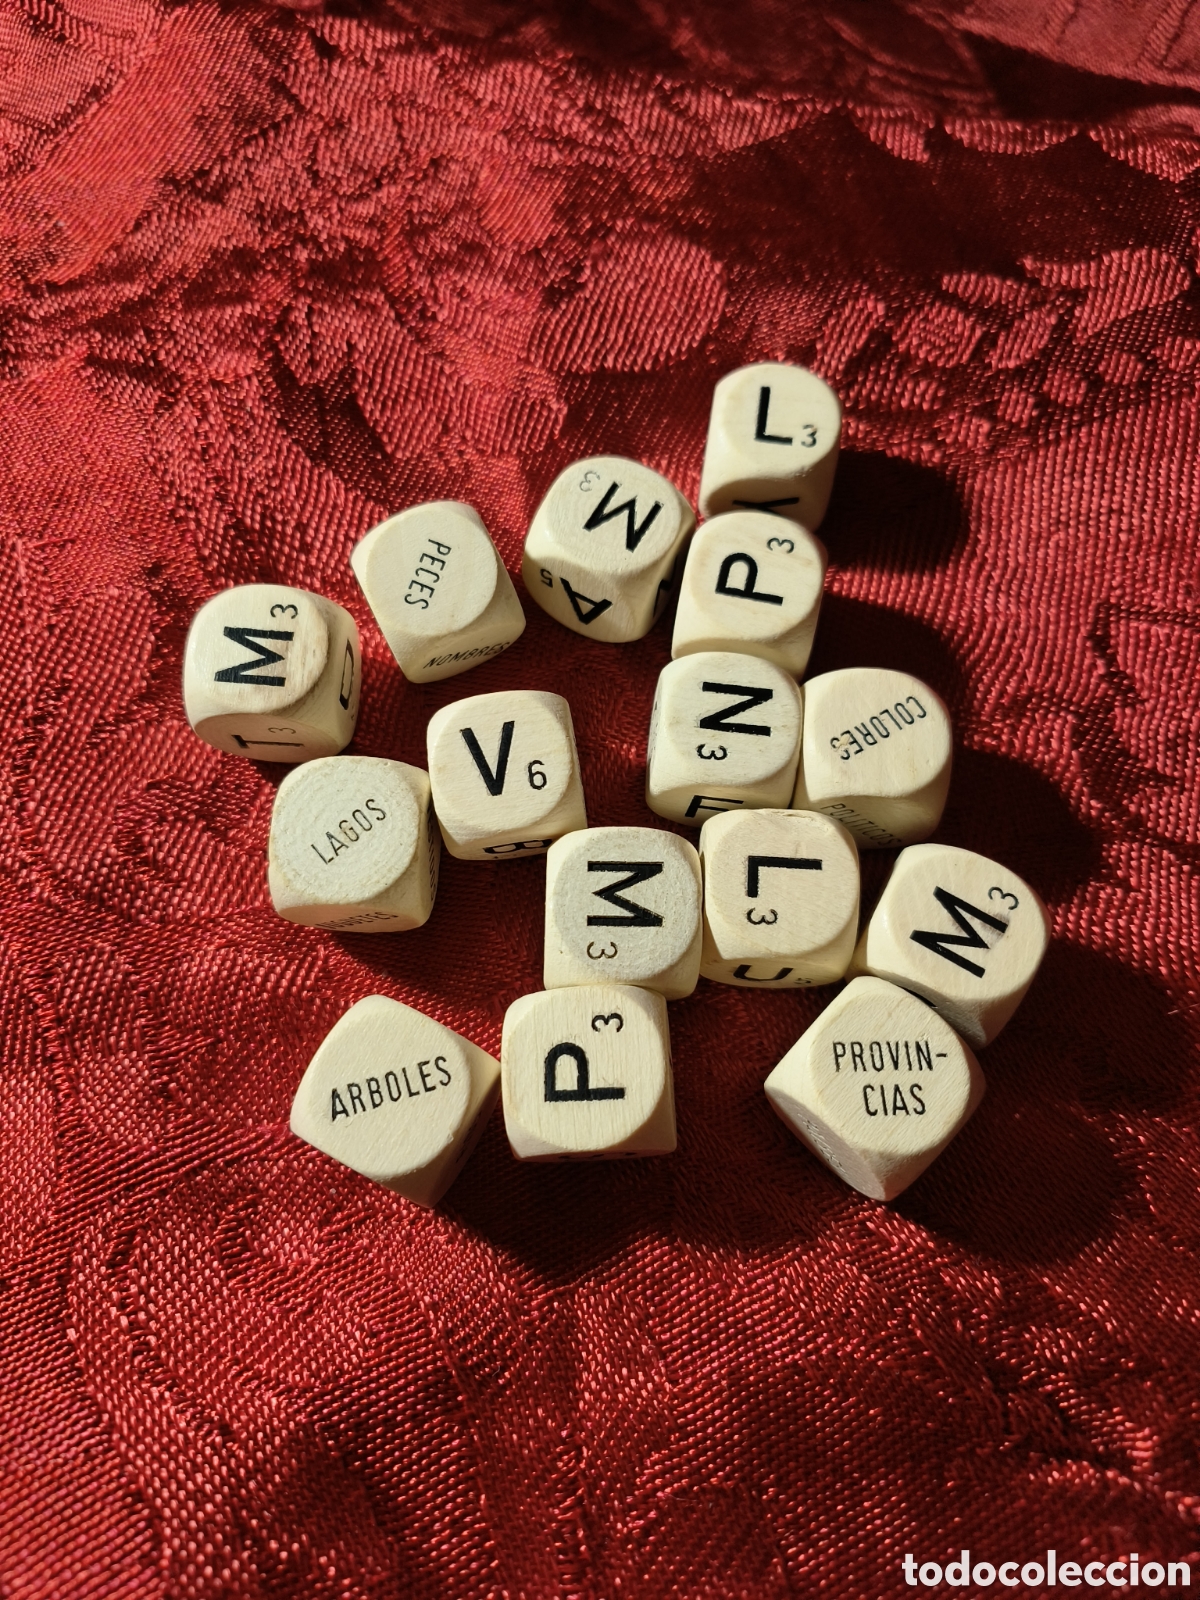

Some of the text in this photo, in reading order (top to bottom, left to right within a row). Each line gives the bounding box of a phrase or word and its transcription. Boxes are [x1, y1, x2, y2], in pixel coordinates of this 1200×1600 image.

[754, 386, 818, 448] L 3
[579, 470, 664, 553] M 3
[404, 538, 452, 610] PECES
[540, 568, 554, 588] 5
[560, 576, 613, 625] A
[715, 537, 795, 606] P 3
[214, 603, 299, 687] M 3
[423, 642, 510, 669] NOMBRES
[697, 681, 774, 761] N 3
[830, 696, 927, 760] COLORES
[460, 720, 547, 796] V 6
[310, 798, 387, 865] LAGOS
[820, 803, 902, 846] POLITICOS
[587, 861, 664, 960] M 3
[746, 855, 823, 925] L 3
[909, 886, 1020, 979] M 3
[733, 964, 794, 982] U
[331, 1055, 453, 1122] ARBOLES
[544, 1041, 626, 1102] P
[591, 1012, 624, 1033] 3
[832, 1040, 948, 1073] PROVIN-
[863, 1083, 927, 1117] CIAS
